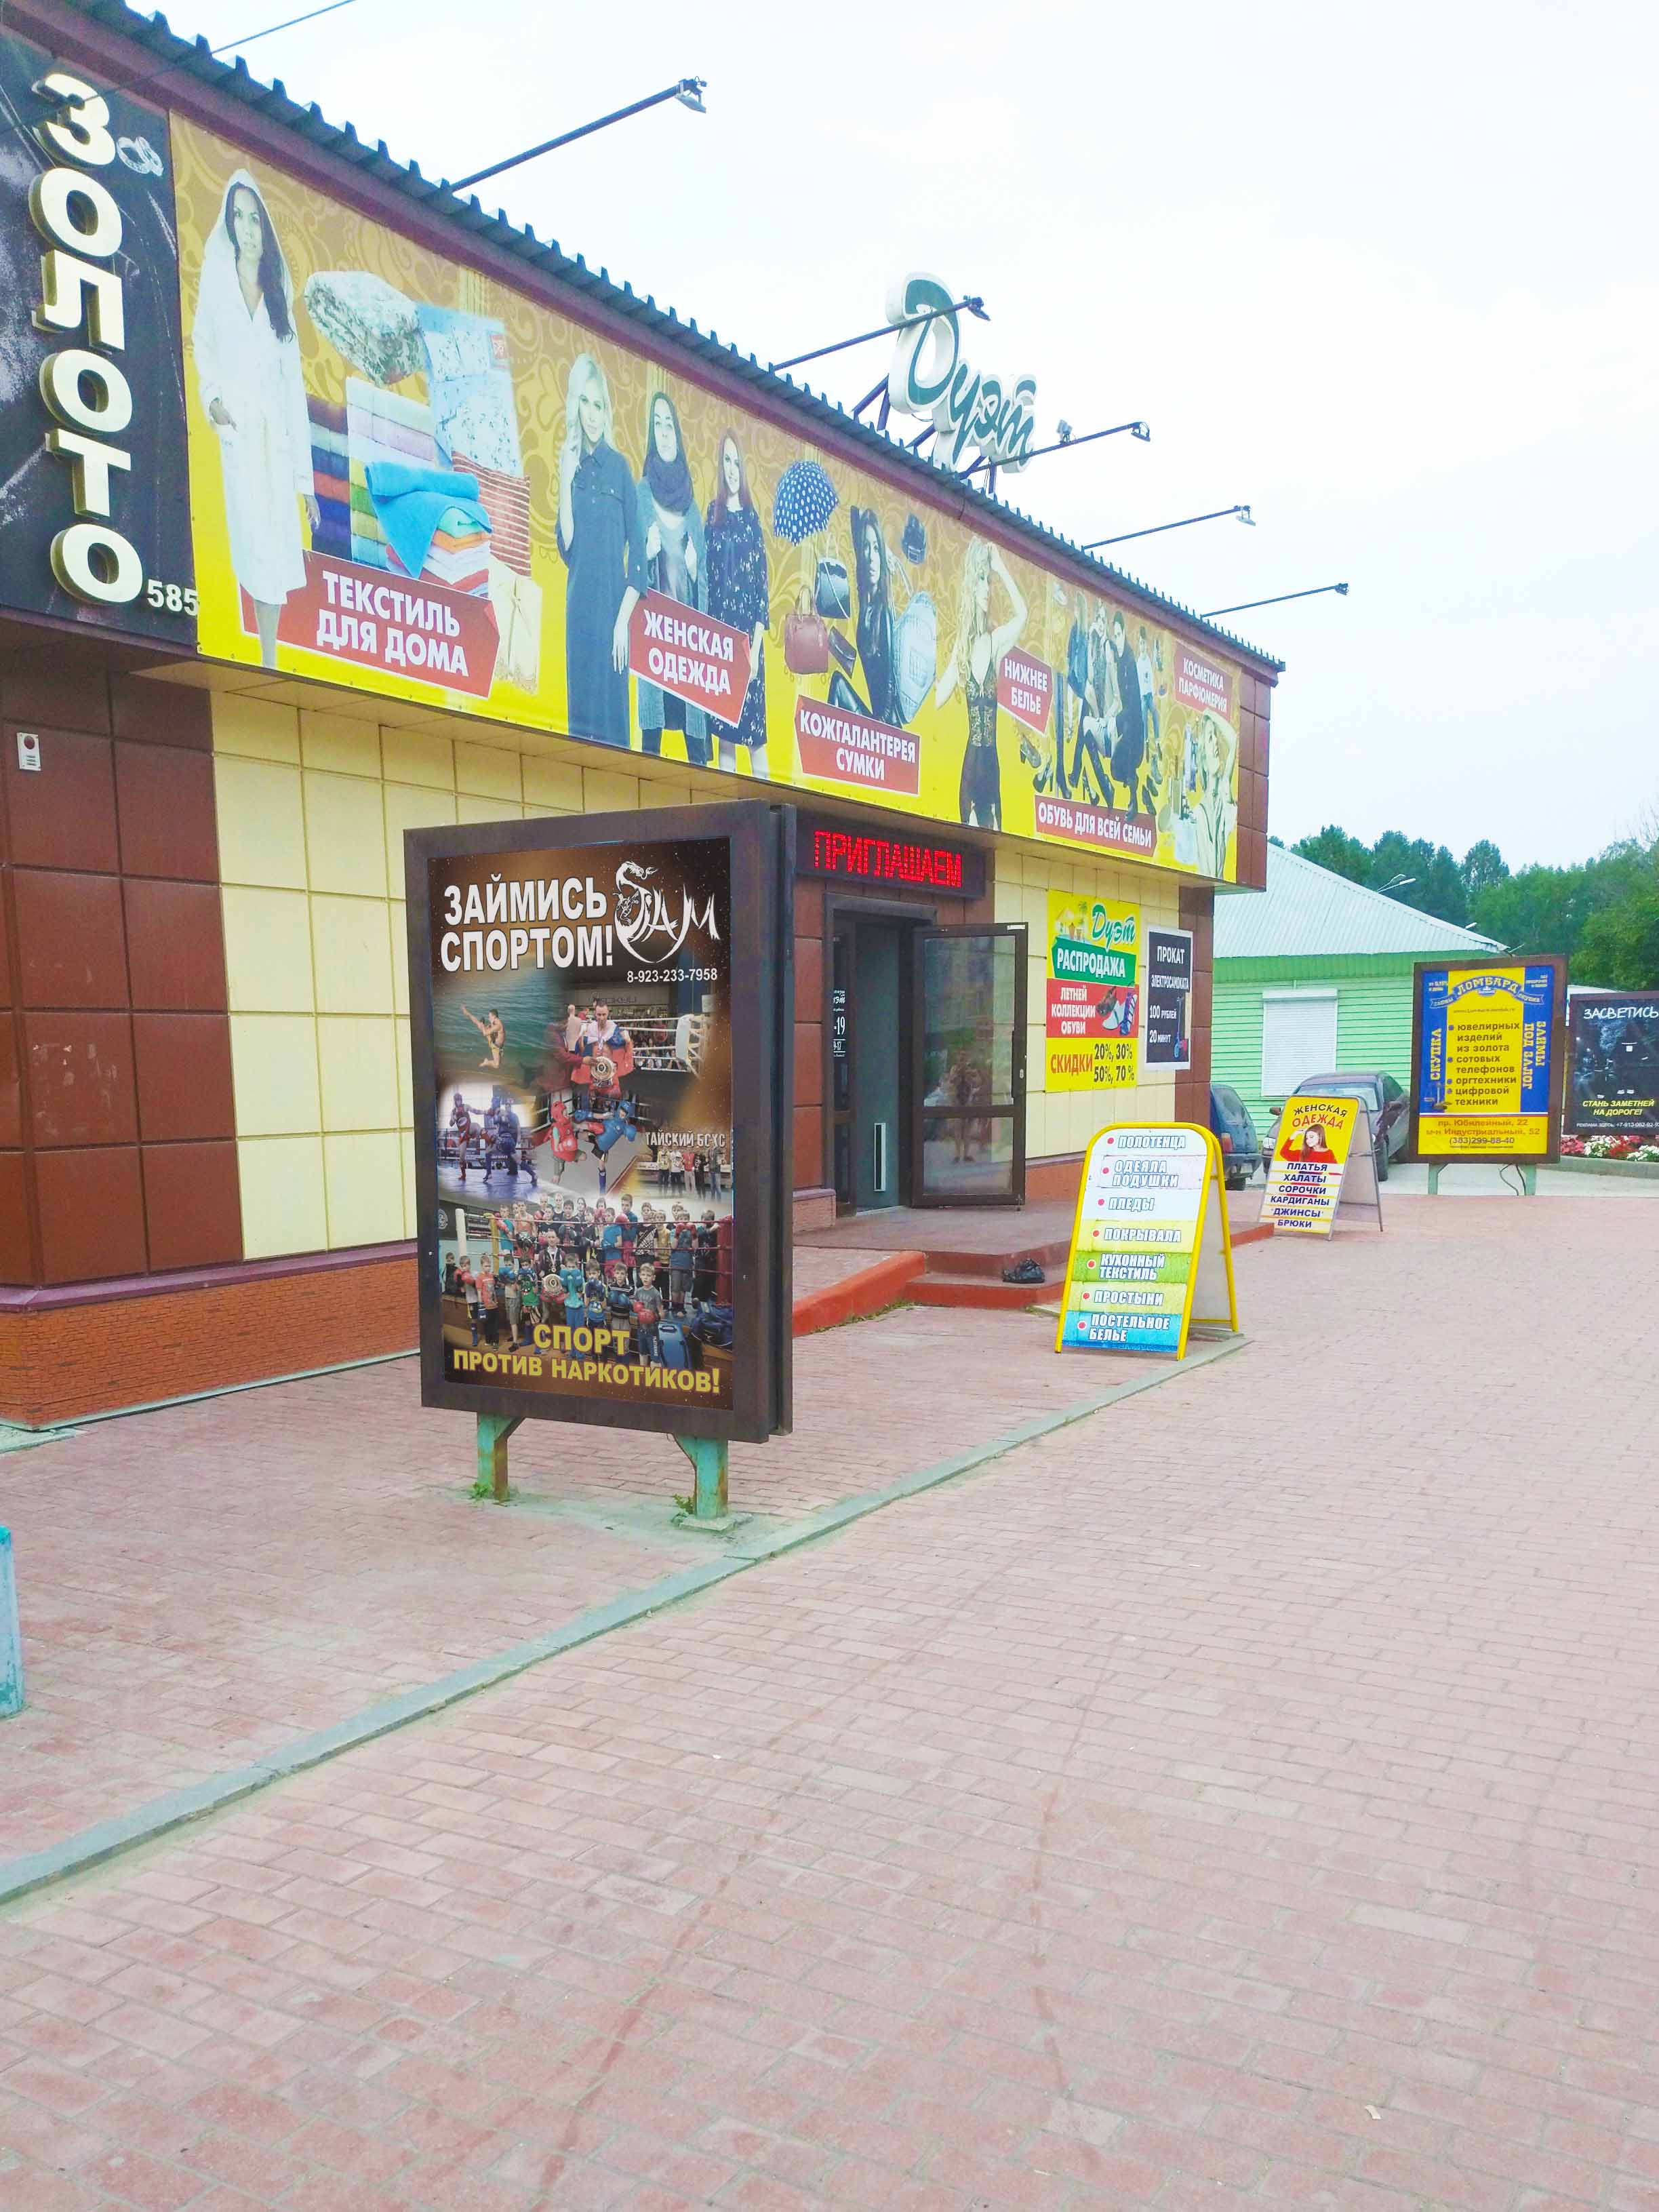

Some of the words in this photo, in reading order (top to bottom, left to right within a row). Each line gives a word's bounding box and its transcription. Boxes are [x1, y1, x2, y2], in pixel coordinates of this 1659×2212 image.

[29, 73, 144, 604] ЗОЛОТО
[146, 579, 198, 616] 585
[321, 570, 460, 637] ТЕКСТИЛЬ
[316, 609, 378, 654] ДЛЯ
[384, 629, 469, 677] ДОМА
[643, 608, 734, 663] ЖЕНСКАЯ
[648, 647, 731, 696] ОДЕЖДА
[1004, 657, 1047, 692] НИЖНЕЕ
[1183, 657, 1224, 691] КОСМЕТИКА
[1010, 686, 1041, 715] БЕЛЬЕ
[1178, 677, 1228, 713] ПАРФЮМЕРИЯ
[800, 709, 916, 764] КОЖГАЛАНТЕРЕЯ
[835, 747, 885, 781] СУМКИ
[1037, 802, 1073, 829] ОБУВЬ
[1074, 811, 1096, 835] ДЛЯ
[1097, 815, 1121, 841] ВСЕЙ
[1122, 821, 1152, 848] СЕМЬИ
[814, 829, 962, 888] ПРИГЛАШАЕМ
[443, 873, 608, 926] ЗАЙМИСЬ
[1092, 903, 1136, 953] Дуэт
[440, 924, 613, 972] СПОРТОМ!
[1156, 945, 1185, 965] ПРОКАТ
[1056, 947, 1125, 979] РАСПРОДАЖА
[626, 968, 718, 983] 8-923-233-7958
[1151, 974, 1189, 990] ЭЛЕКТРОСАМОКАТА
[1060, 985, 1087, 1002] ЛЕТНЕЙ
[1457, 976, 1519, 995] ЛОМБАРД
[1052, 1003, 1096, 1023] КОЛЛЕКЦИИ
[1149, 1005, 1161, 1019] 100
[1161, 1008, 1177, 1019] РУБЛЕЙ
[1060, 1021, 1086, 1035] ОБУВИ
[1457, 1022, 1520, 1031] ювелирных
[1149, 1029, 1157, 1044] 20
[1157, 1034, 1172, 1044] МИНУТ
[1457, 1033, 1502, 1042] изделий
[1094, 1043, 1114, 1061] 20%,
[1115, 1043, 1132, 1059] 30%
[1430, 1027, 1441, 1080] СКУПКА
[1473, 1044, 1510, 1052] золота
[1050, 1054, 1093, 1076] СКИДКИ
[1456, 1065, 1515, 1074] телефонов
[1455, 1076, 1517, 1086] оргтехники
[1455, 1086, 1509, 1097] цифровой
[1454, 1098, 1498, 1106] техники
[1610, 1099, 1655, 1107] ЗАМЕТНЕЙ
[1293, 1103, 1348, 1118] ЖЕНСКАЯ
[1605, 1108, 1643, 1117] ДОРОГЕ!
[1292, 1113, 1344, 1130] ОДЕЖДА
[645, 1128, 694, 1147] ТАЙСКИЙ
[1117, 1135, 1186, 1150] ПОЛОТЕНЦА
[1114, 1160, 1167, 1174] ОДЕЯЛА
[1287, 1162, 1327, 1171] ПЛАТЬЯ
[1112, 1174, 1179, 1188] ПОДУШКИ
[1283, 1174, 1326, 1183] ХАЛАТЫ
[1279, 1185, 1326, 1195] СОРОЧКИ
[1108, 1196, 1155, 1212] ПЛЕДЫ
[1270, 1196, 1330, 1206] КАРДИГАНЫ
[1273, 1208, 1321, 1217] ДЖИНСЫ
[1277, 1219, 1312, 1228] БРЮКИ
[1104, 1227, 1182, 1243] ПОКРЫВАЛА
[1100, 1253, 1165, 1268] КУХОННЫЙ
[1099, 1267, 1157, 1281] ТЕКСТИЛЬ
[1093, 1290, 1165, 1305] ПРОСТЫНИ
[1090, 1314, 1171, 1330] ПОСТЕЛЬНОЕ
[533, 1324, 630, 1355] СПОРТ
[1089, 1327, 1127, 1343] БЕЛЬЕ
[454, 1349, 542, 1377] ПРОТИВ
[552, 1359, 720, 1394] НАРКОТИКОВ!
